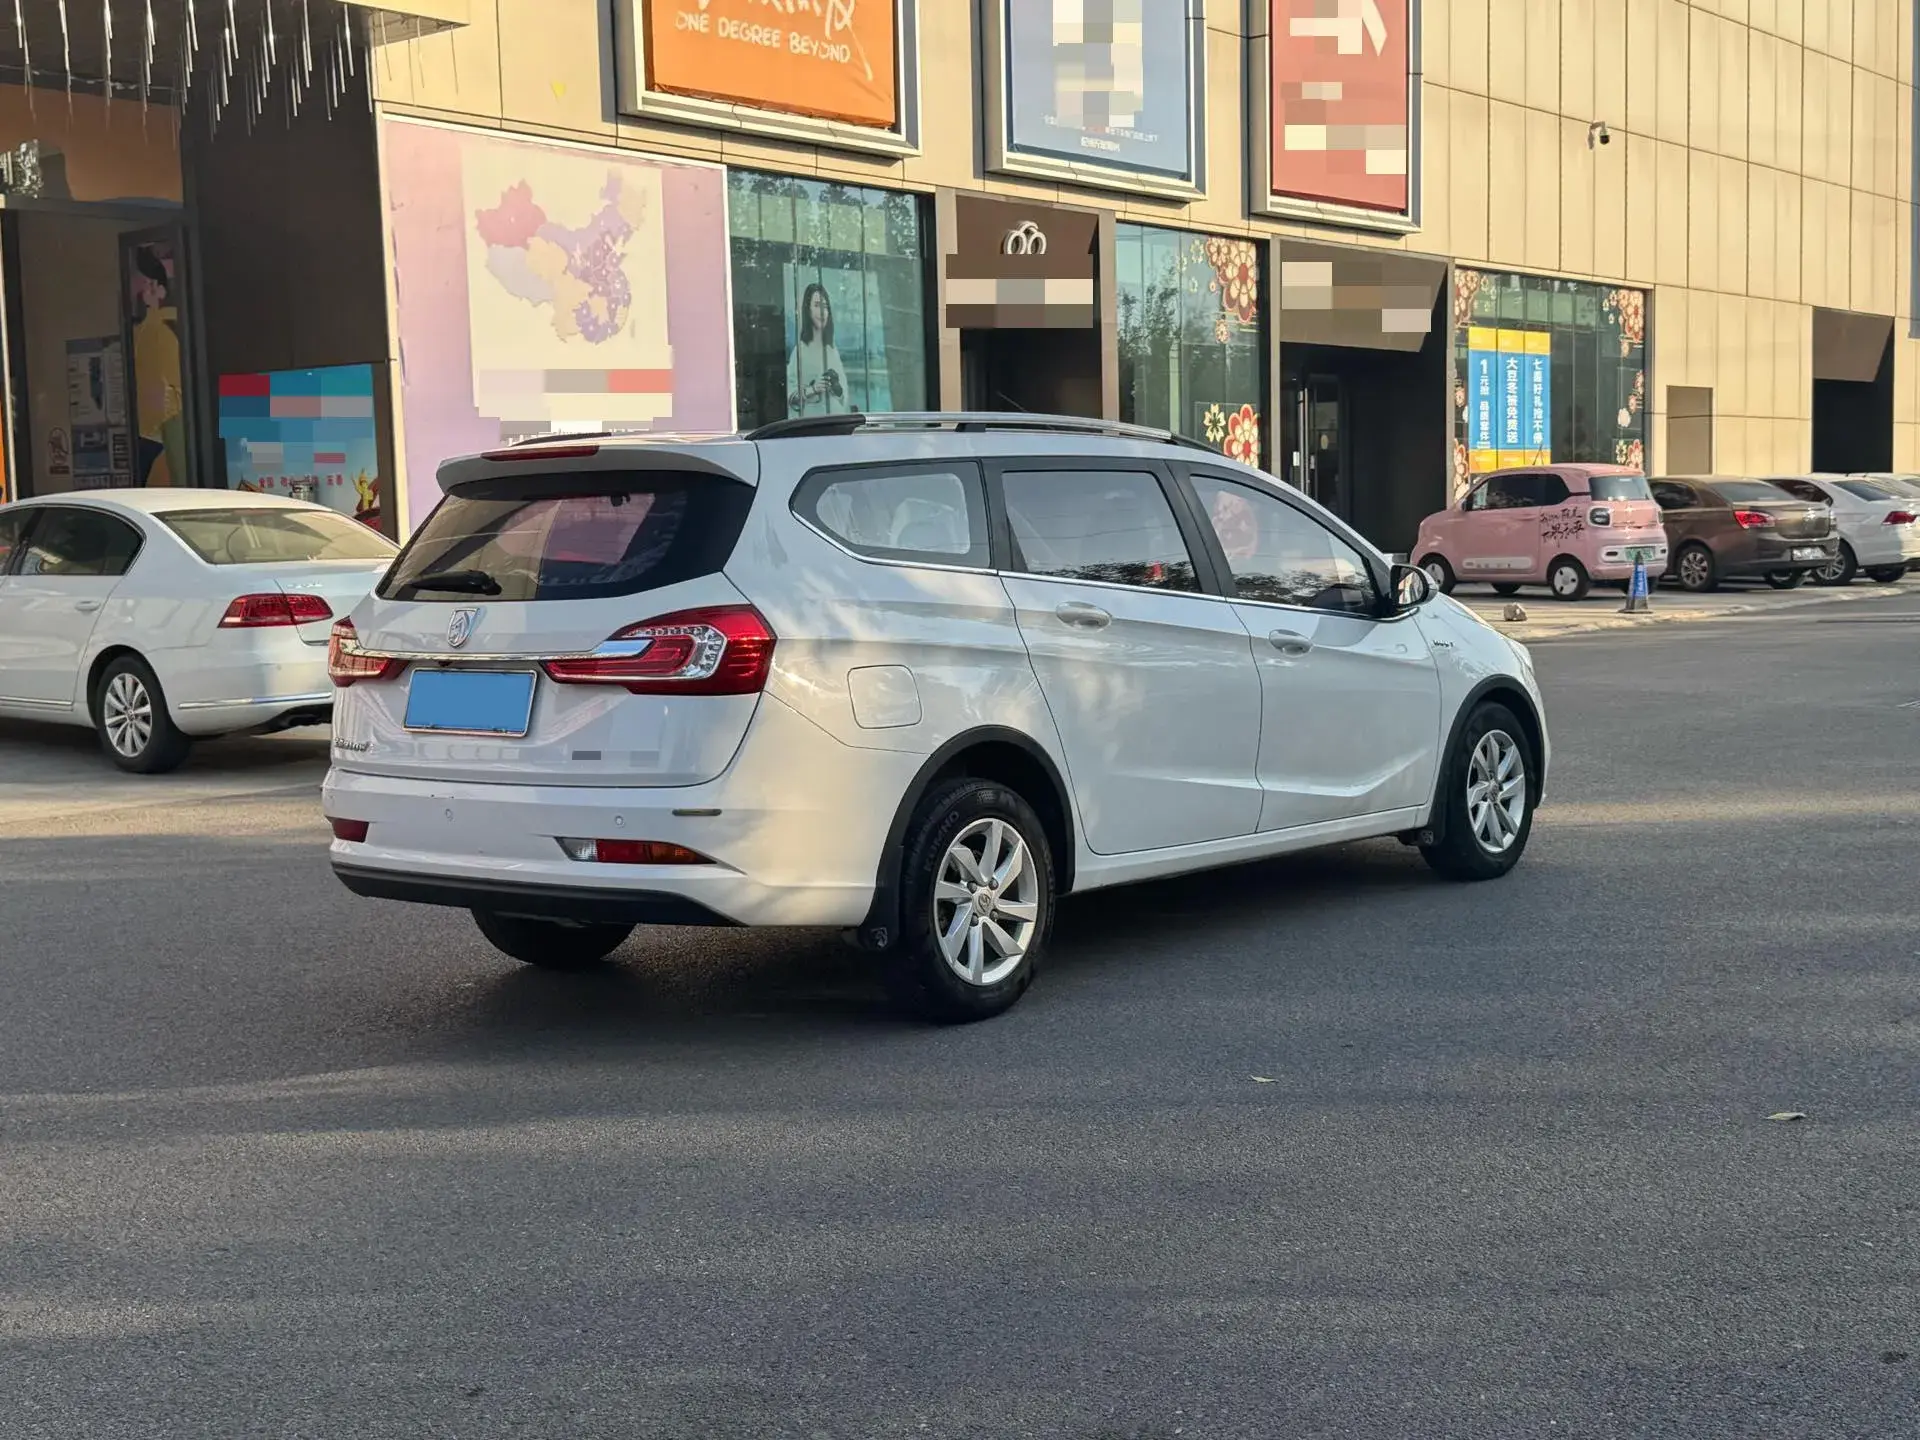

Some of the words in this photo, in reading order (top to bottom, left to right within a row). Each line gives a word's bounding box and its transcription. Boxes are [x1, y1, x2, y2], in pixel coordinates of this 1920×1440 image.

[675, 11, 710, 33] ONE
[718, 17, 781, 48] DEGREE
[789, 32, 851, 63] BEYOND
[923, 810, 960, 872] KUMHO
